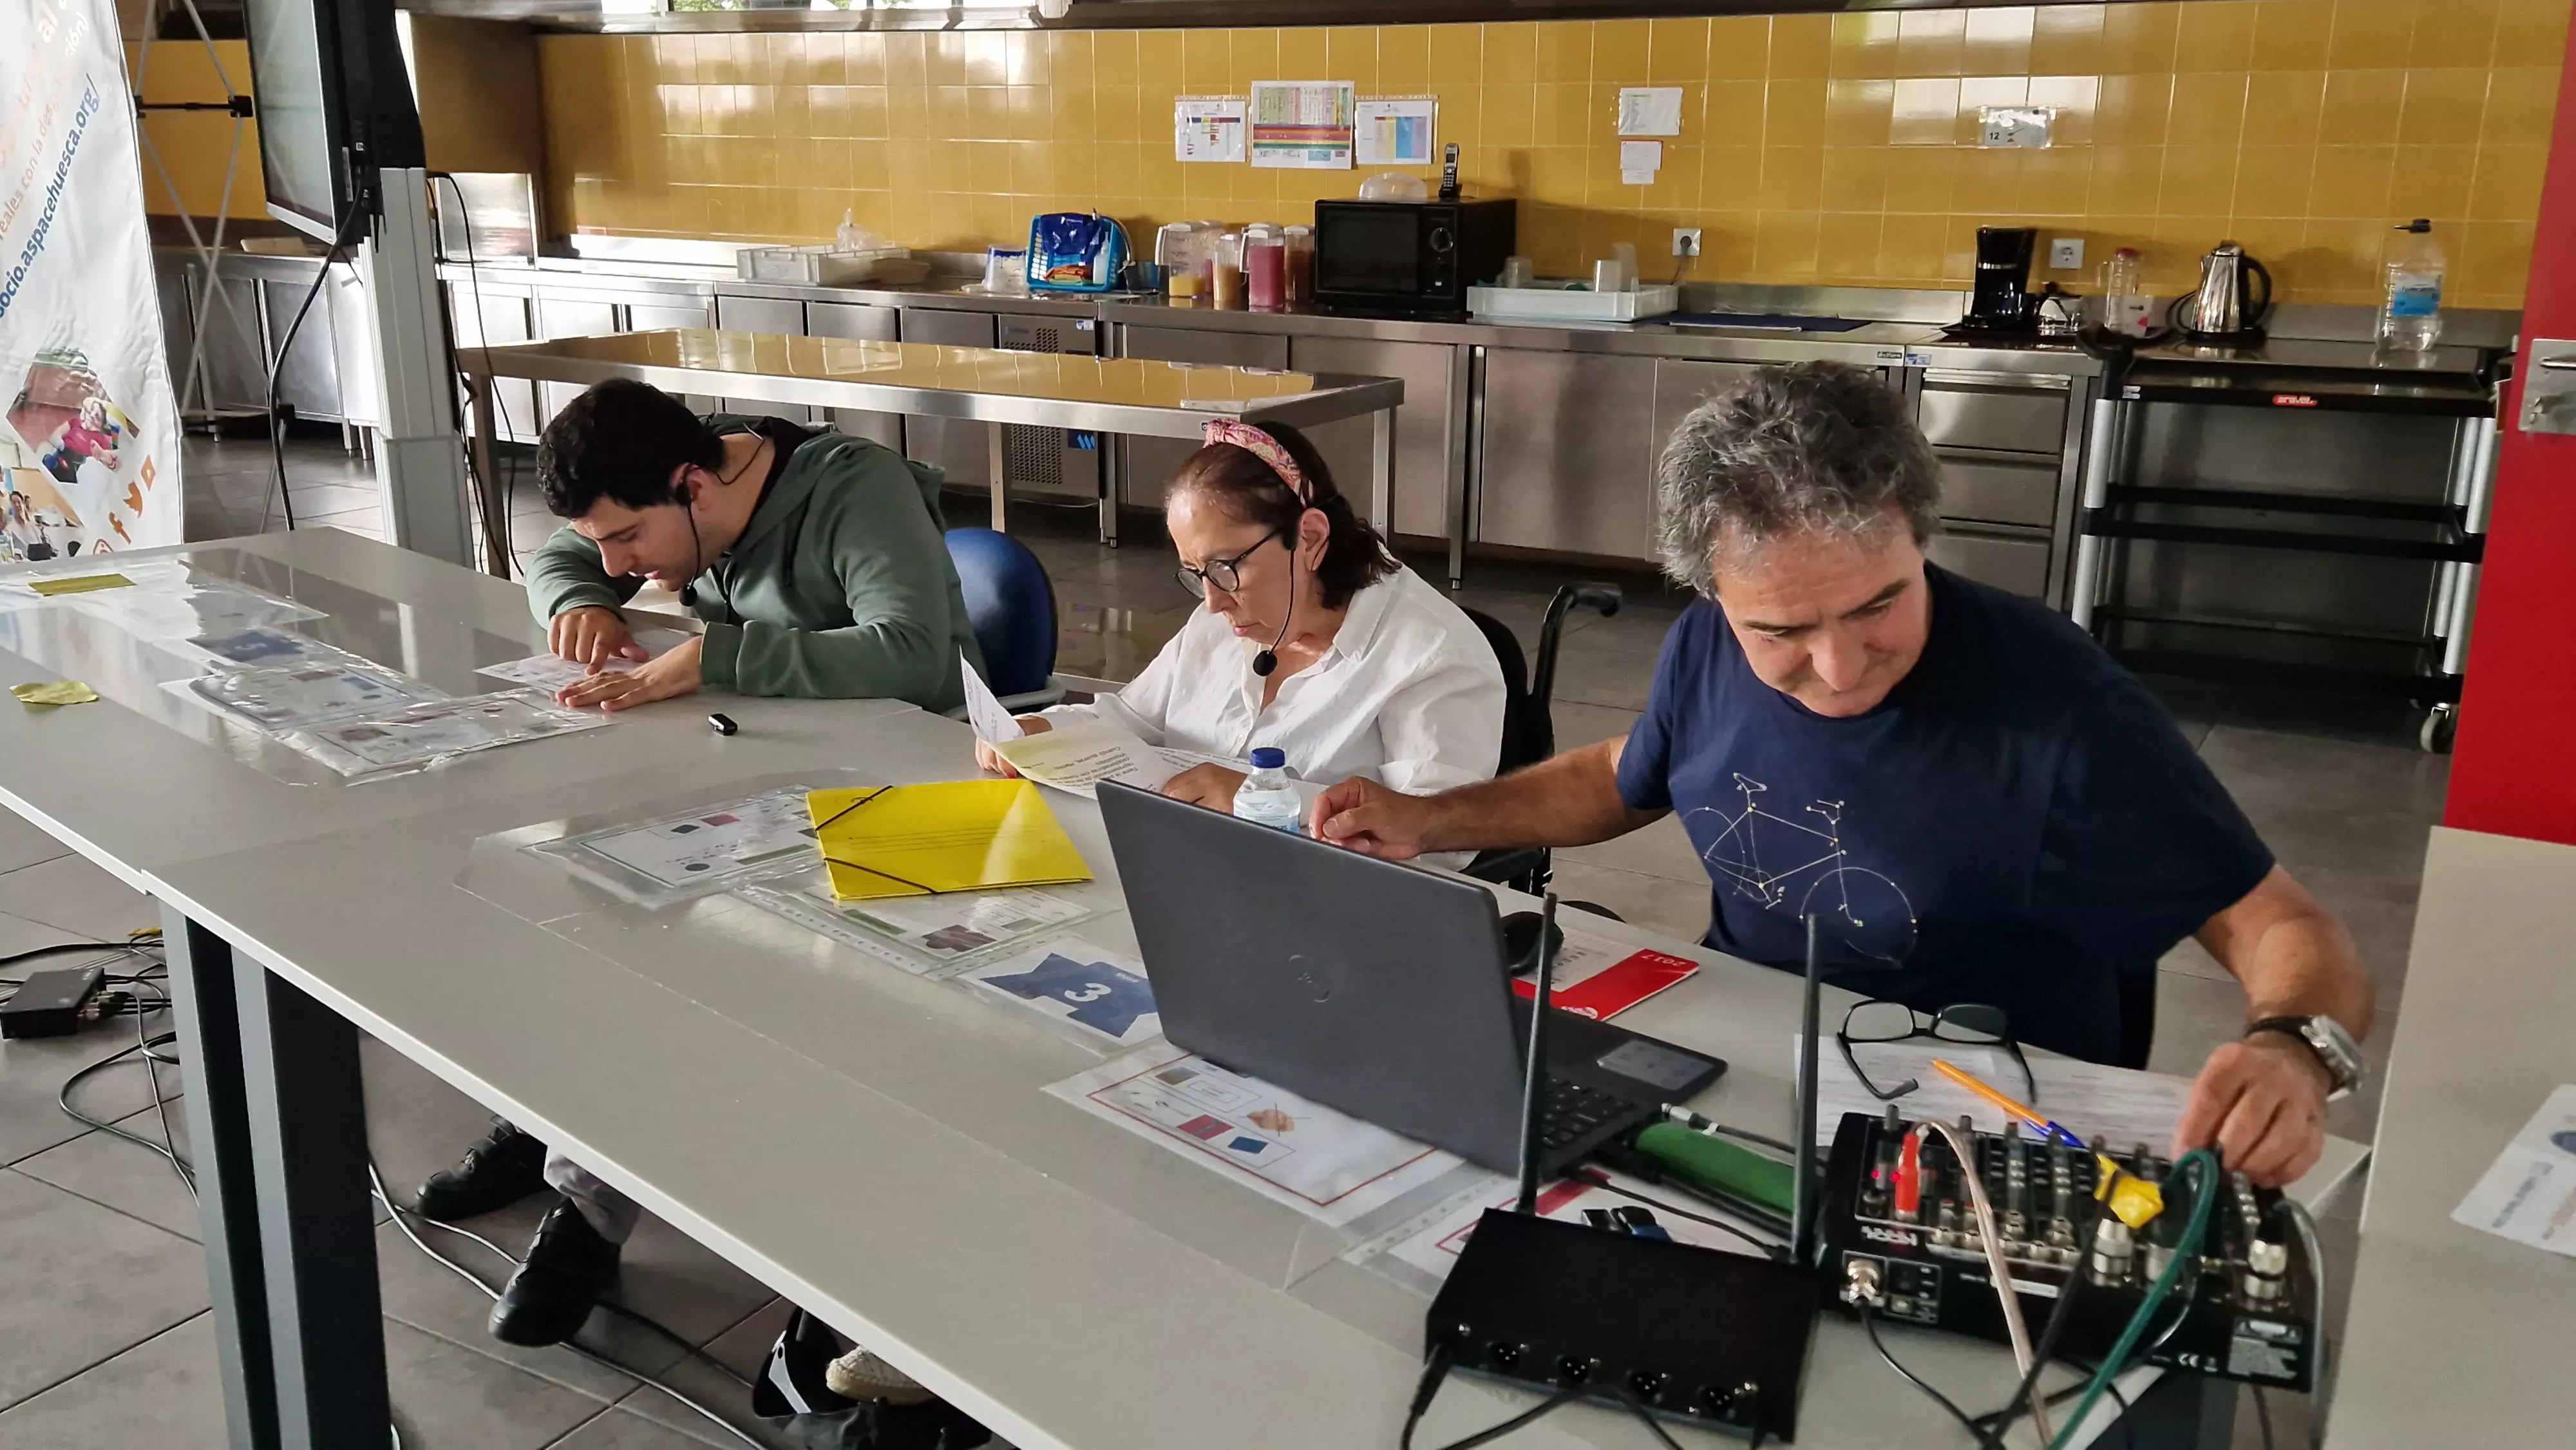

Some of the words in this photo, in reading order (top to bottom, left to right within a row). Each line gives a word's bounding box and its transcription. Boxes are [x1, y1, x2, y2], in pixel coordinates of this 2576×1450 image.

[1989, 131, 2000, 140] 12
[1641, 953, 1687, 968] 2017
[1064, 982, 1112, 1003] 3
